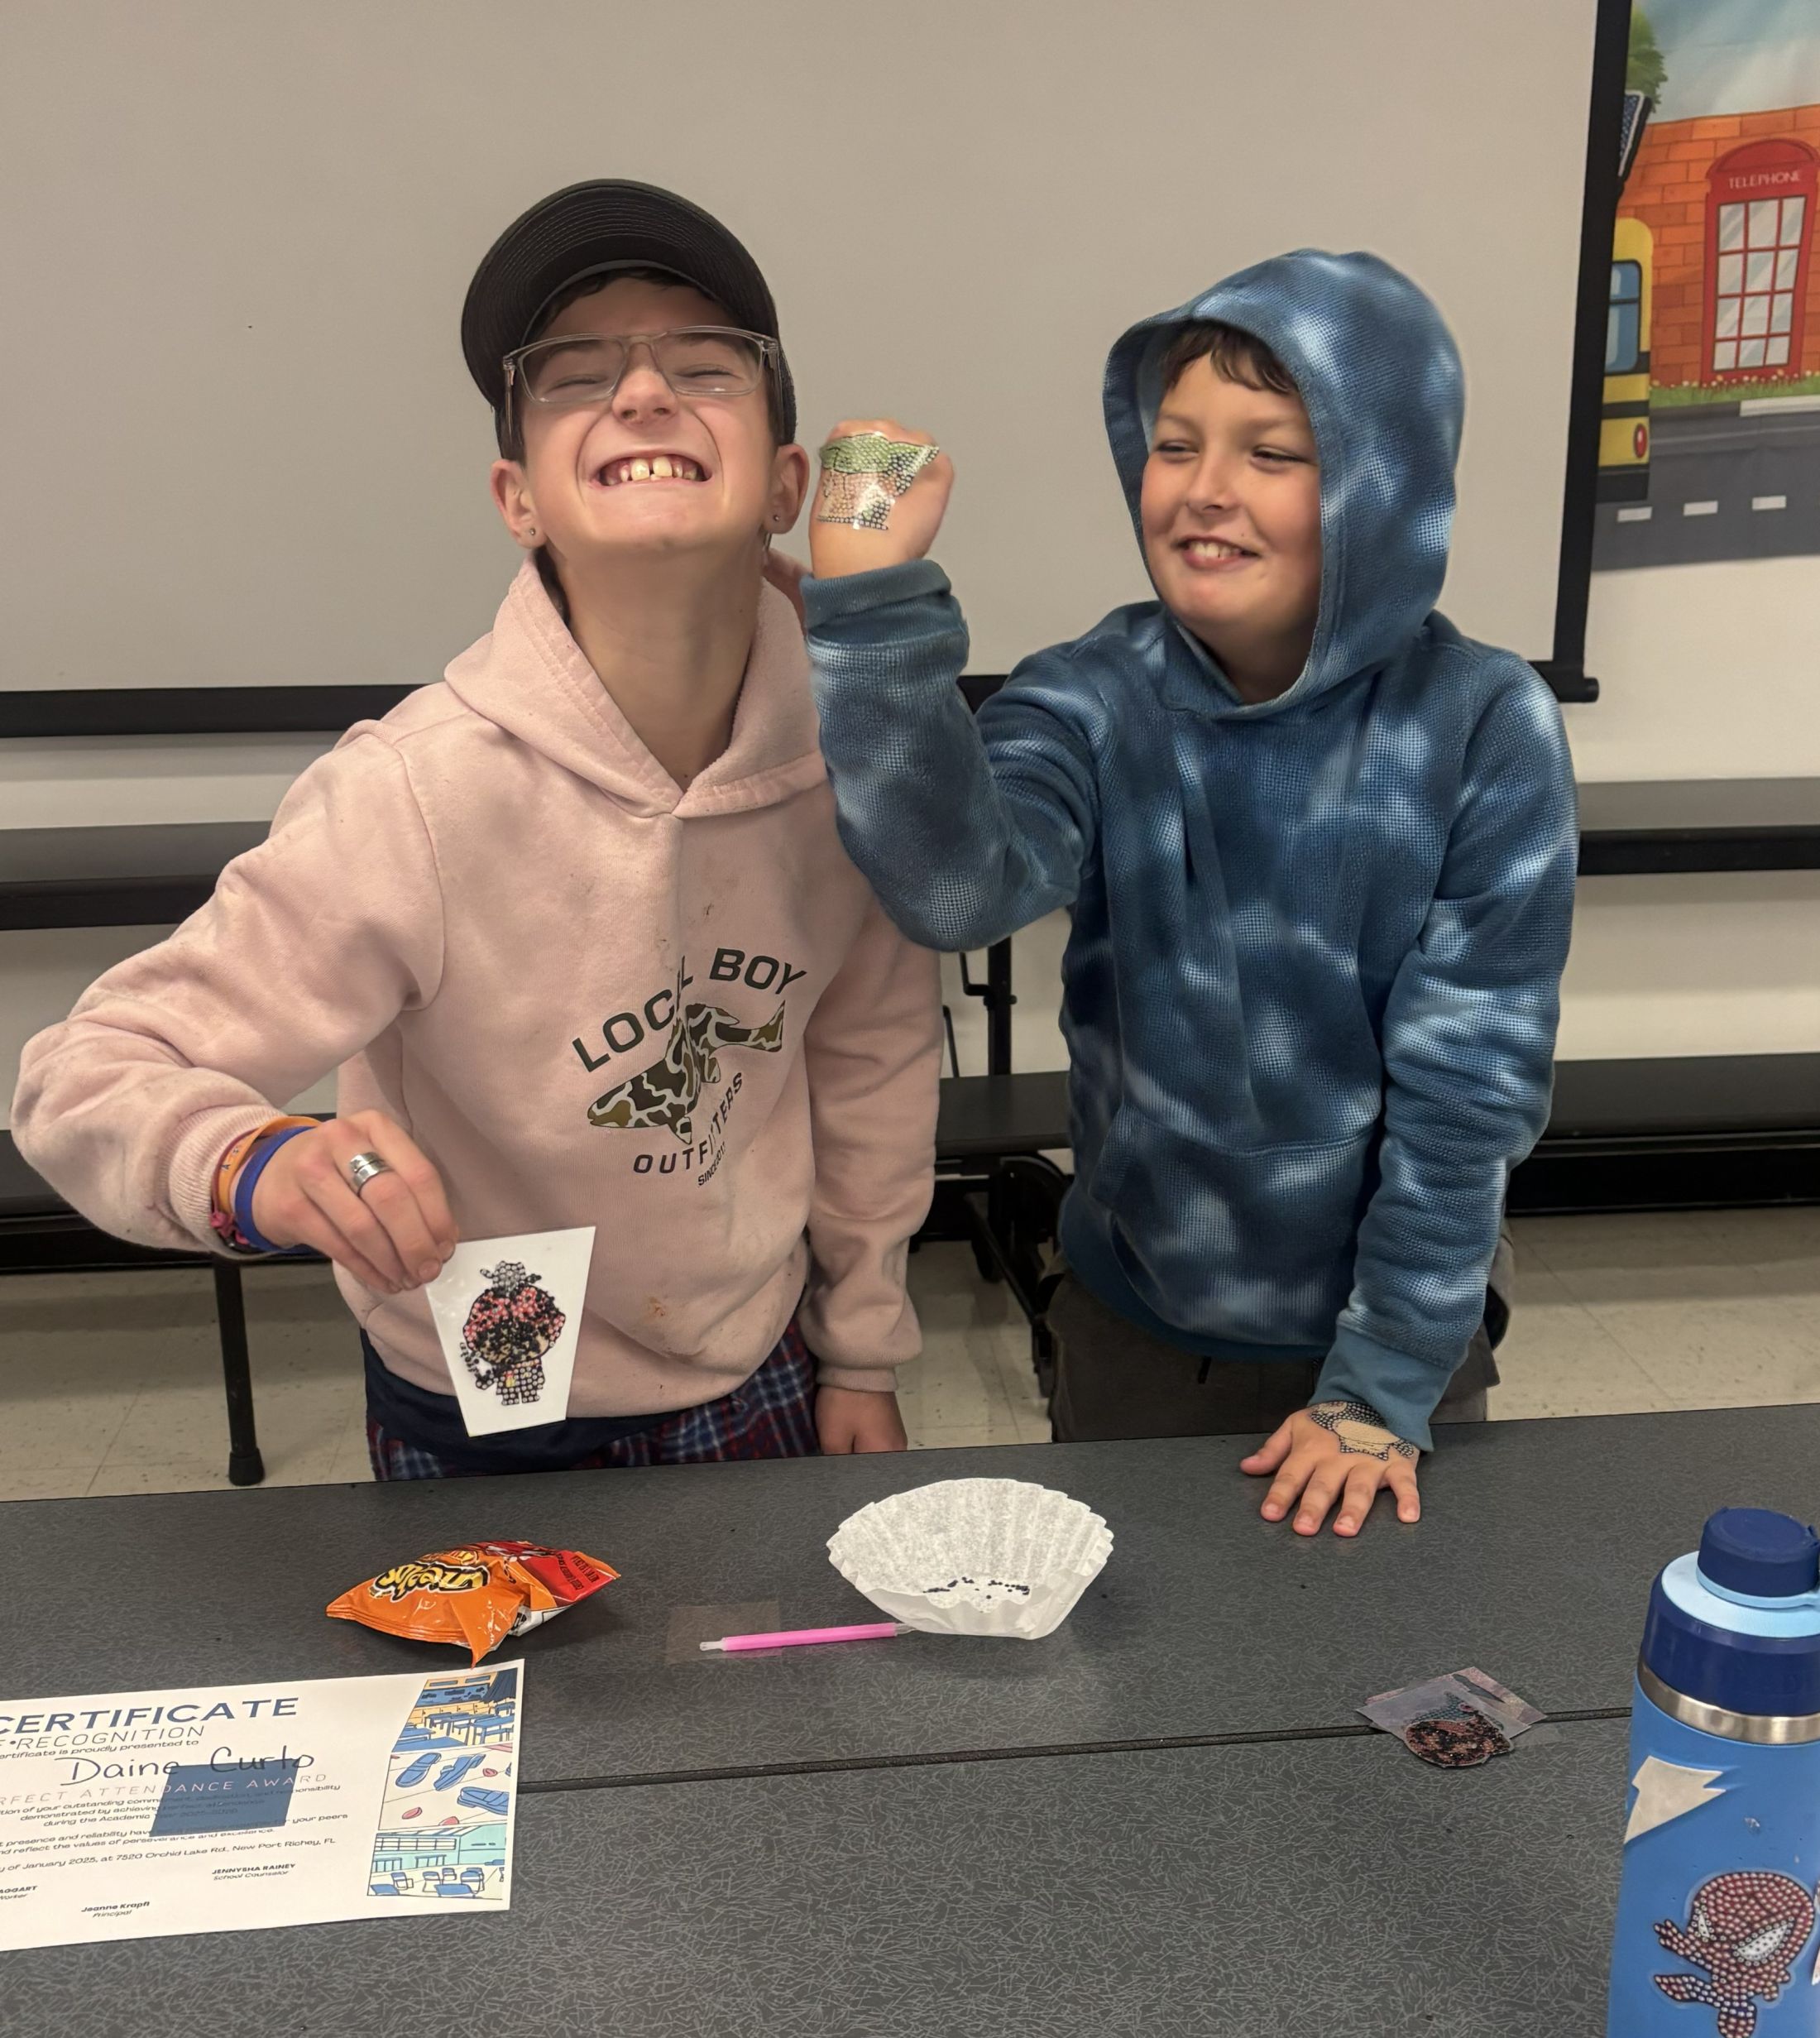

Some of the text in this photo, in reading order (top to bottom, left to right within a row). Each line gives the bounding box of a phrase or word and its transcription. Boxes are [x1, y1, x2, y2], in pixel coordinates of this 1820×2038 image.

[1729, 170, 1800, 189] TELEPHONE
[572, 947, 807, 1073] LOCL BOY
[633, 1072, 743, 1174] OUTFITERS
[16, 1725, 205, 1750] RECOGNITION
[71, 1745, 117, 1754] proudly
[119, 1739, 183, 1749] presented
[55, 1757, 180, 1786] Daine
[80, 1781, 234, 1798] ATTENDANCE
[247, 1773, 327, 1788] AWARD
[21, 1809, 96, 1821] demonstrated
[98, 1807, 111, 1815] by
[36, 1805, 61, 1814] your
[63, 1800, 125, 1810] outstanding
[44, 1819, 76, 1827] during
[98, 1814, 151, 1822] Academic
[318, 1814, 348, 1822] peers
[6, 1837, 56, 1847] presence
[80, 1831, 127, 1839] reliability
[13, 1845, 50, 1854] reflect
[22, 1860, 66, 1870] January
[69, 1857, 98, 1865] 2025,
[116, 1853, 143, 1861] 7520
[146, 1850, 182, 1858] Orchid
[285, 1839, 322, 1849] Richey,
[262, 1863, 296, 1871] RAINEY
[213, 1873, 244, 1881] School
[81, 1904, 118, 1912] Jeanne
[93, 1909, 132, 1918] Principal
